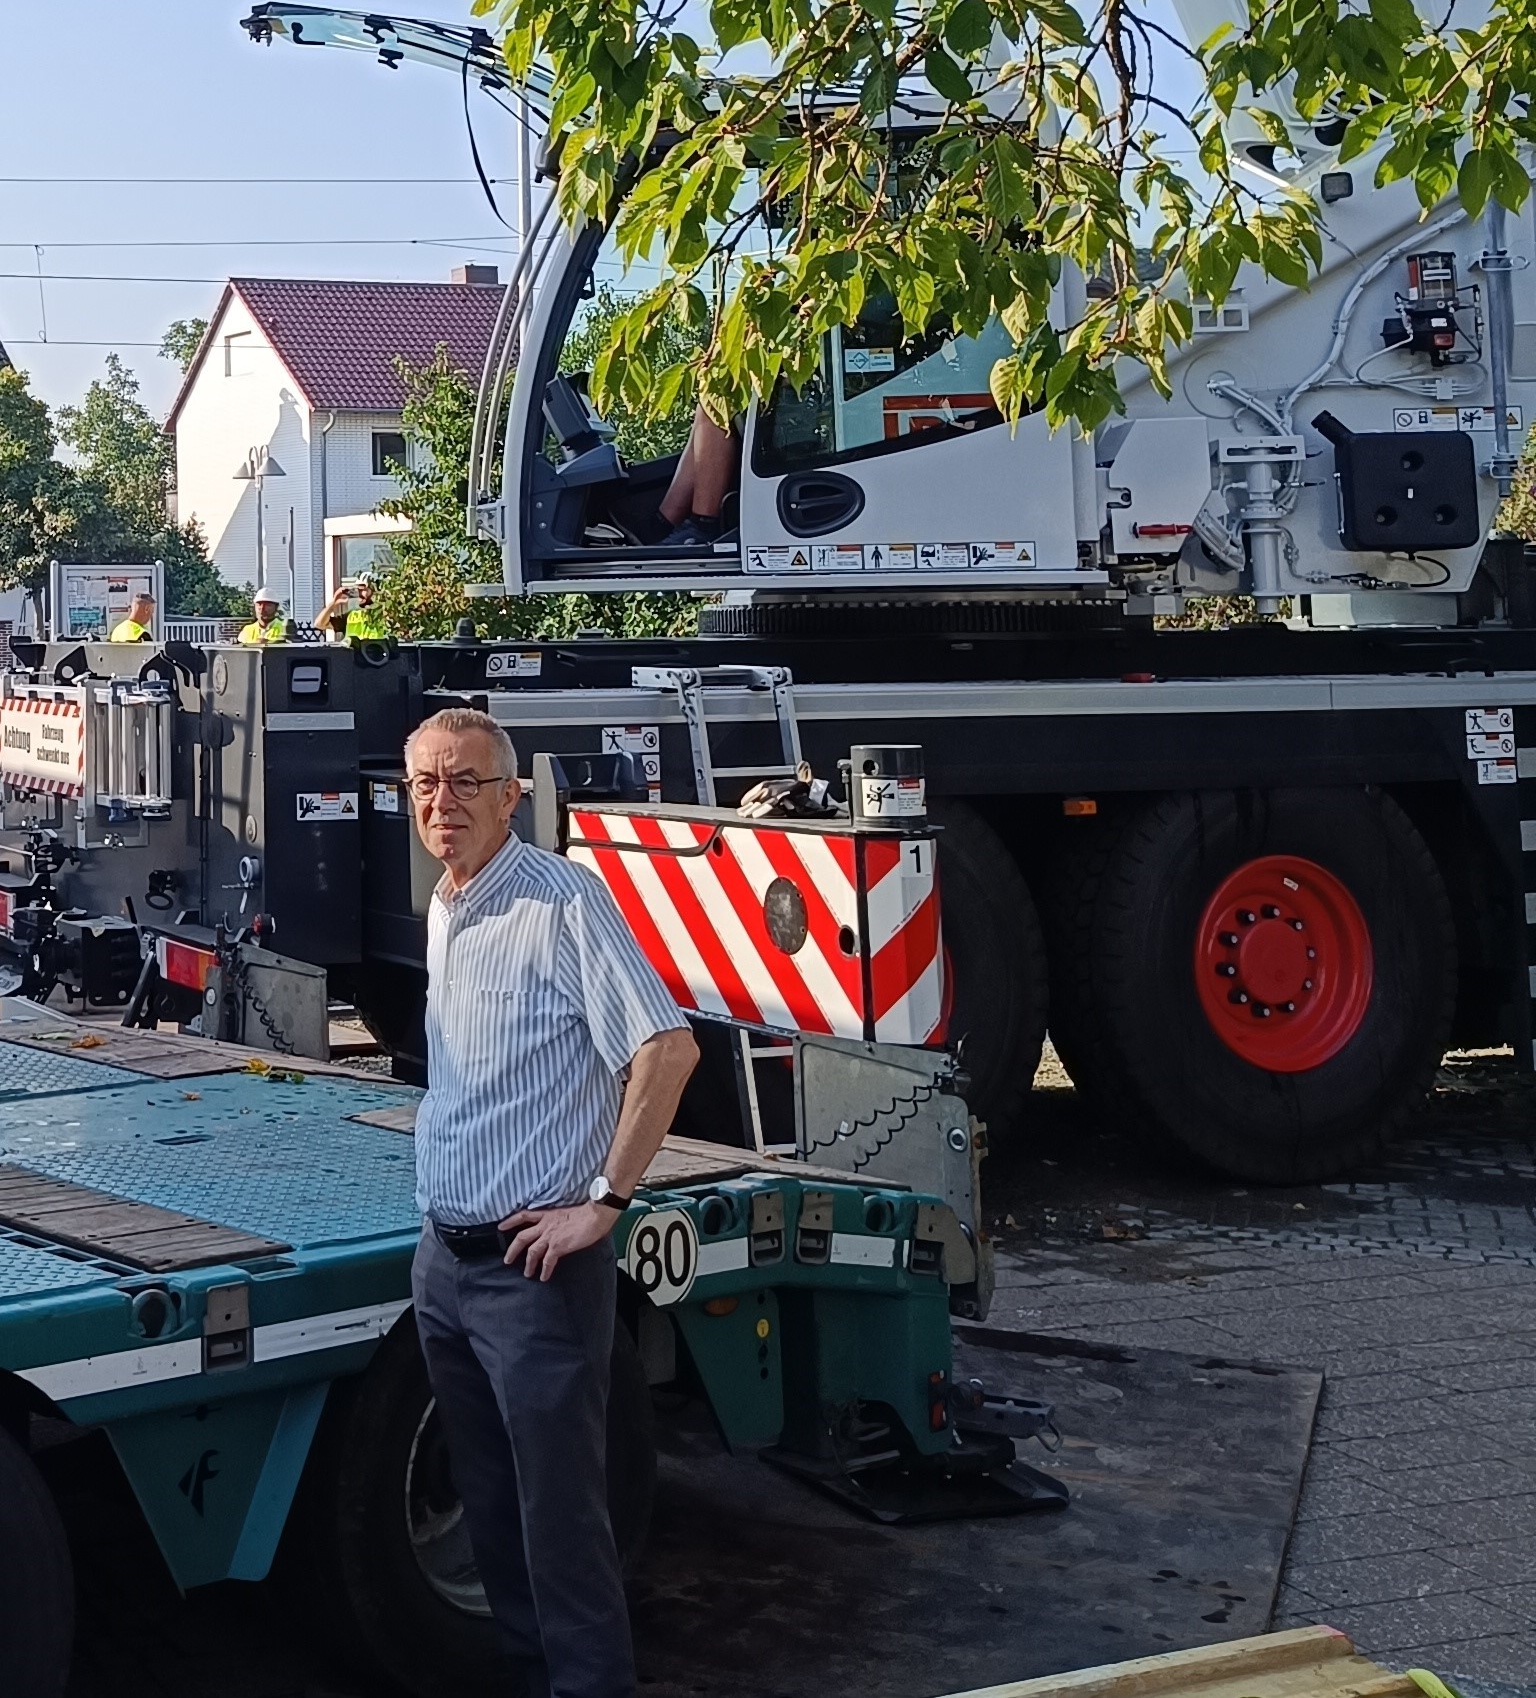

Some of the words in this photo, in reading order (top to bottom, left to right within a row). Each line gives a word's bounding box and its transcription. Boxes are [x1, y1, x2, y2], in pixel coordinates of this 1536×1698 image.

[4, 724, 31, 753] Achtung
[41, 723, 64, 743] Fahrzeug
[36, 745, 60, 764] schwenkt
[60, 751, 70, 766] aus
[909, 844, 921, 874] 1
[635, 1219, 692, 1293] 80
